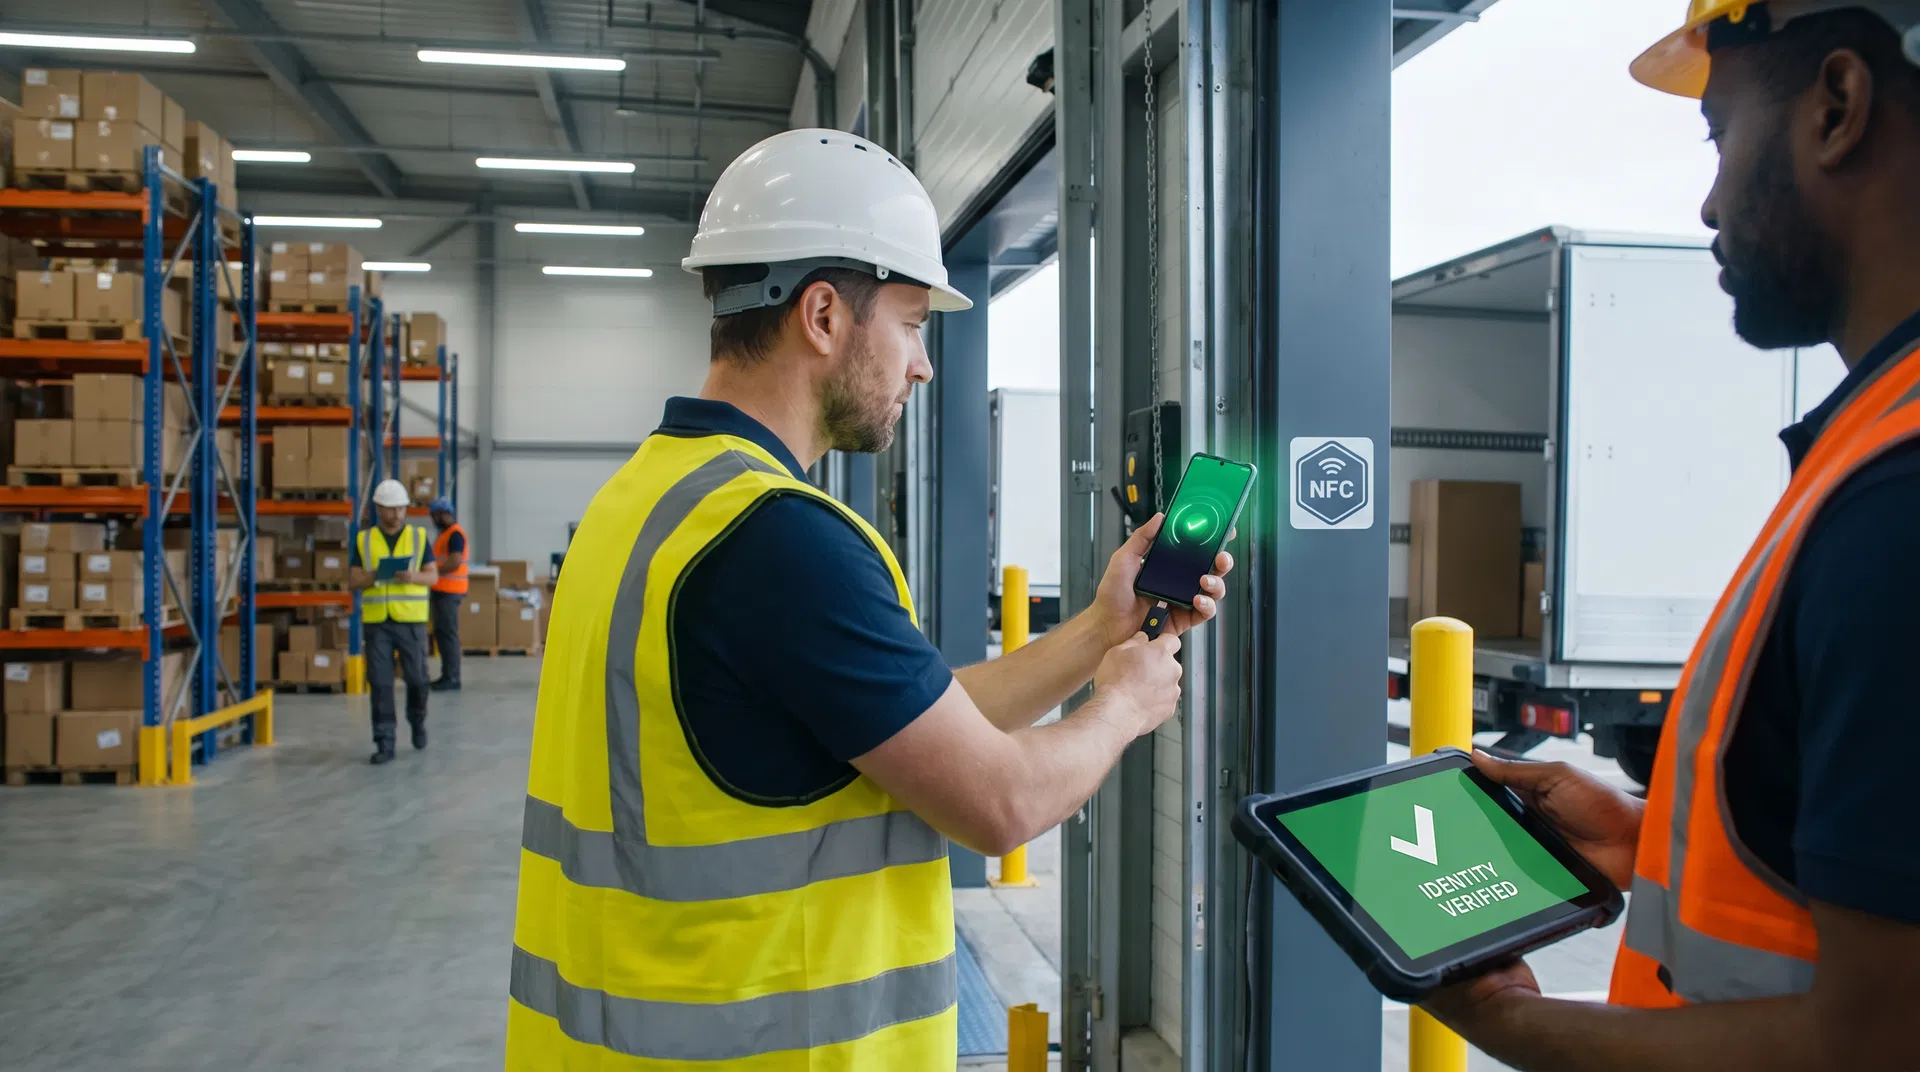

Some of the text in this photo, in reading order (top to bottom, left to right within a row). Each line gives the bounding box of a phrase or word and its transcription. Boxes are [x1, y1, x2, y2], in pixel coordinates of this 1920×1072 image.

[1310, 480, 1354, 499] NFC
[1418, 861, 1499, 900] IDENTITY
[1437, 880, 1519, 917] VERIFIED
